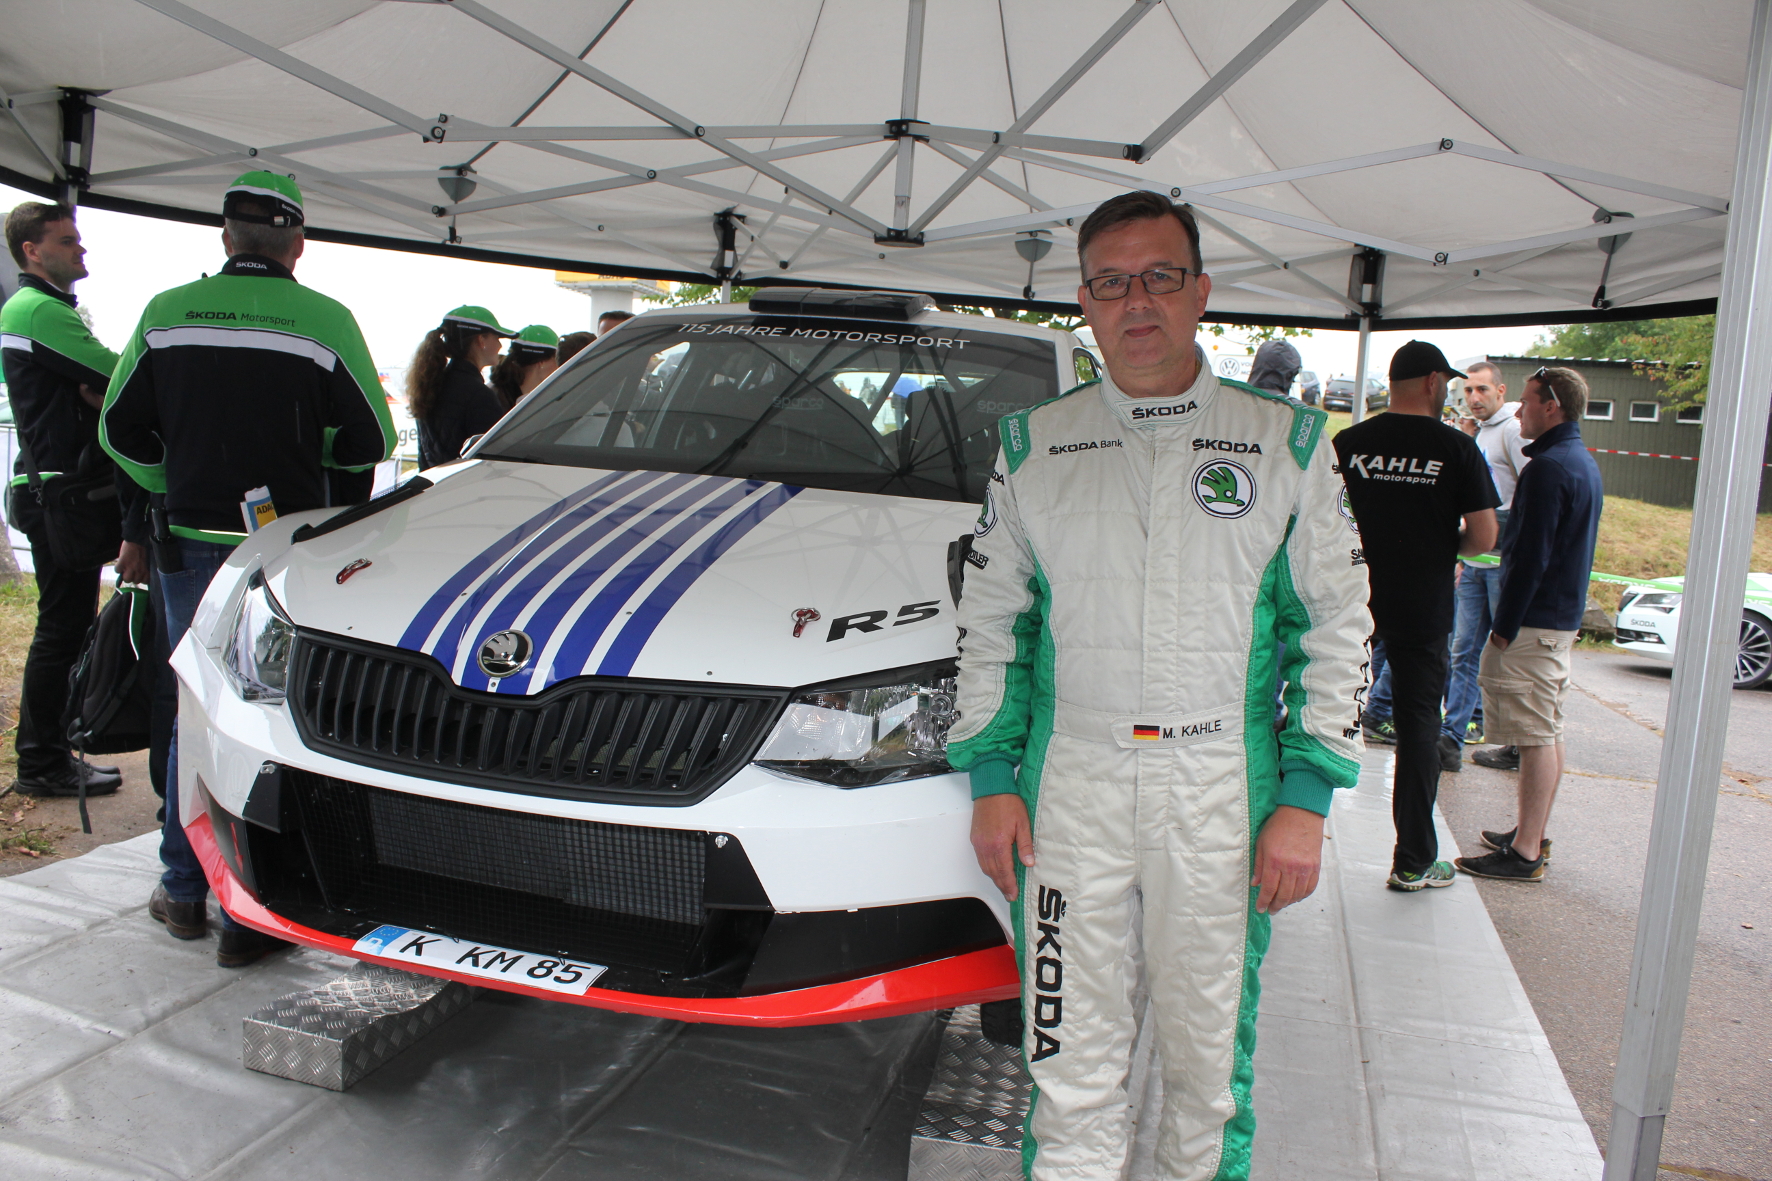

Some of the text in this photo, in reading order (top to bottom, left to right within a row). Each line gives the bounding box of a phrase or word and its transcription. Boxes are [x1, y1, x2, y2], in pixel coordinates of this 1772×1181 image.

[185, 310, 296, 327] ŠKODA Motorsport
[677, 322, 971, 350] 115 JAHRE MOTORSPORT
[1131, 400, 1198, 420] ŠKODA
[1048, 438, 1123, 455] ŠKODA Bank
[1191, 437, 1263, 455] ŠKODA
[1349, 454, 1444, 479] KAHLE
[1372, 473, 1437, 486] motorsport
[826, 599, 942, 643] R5
[1162, 719, 1222, 739] M. KAHLE
[398, 935, 592, 985] K KM 85
